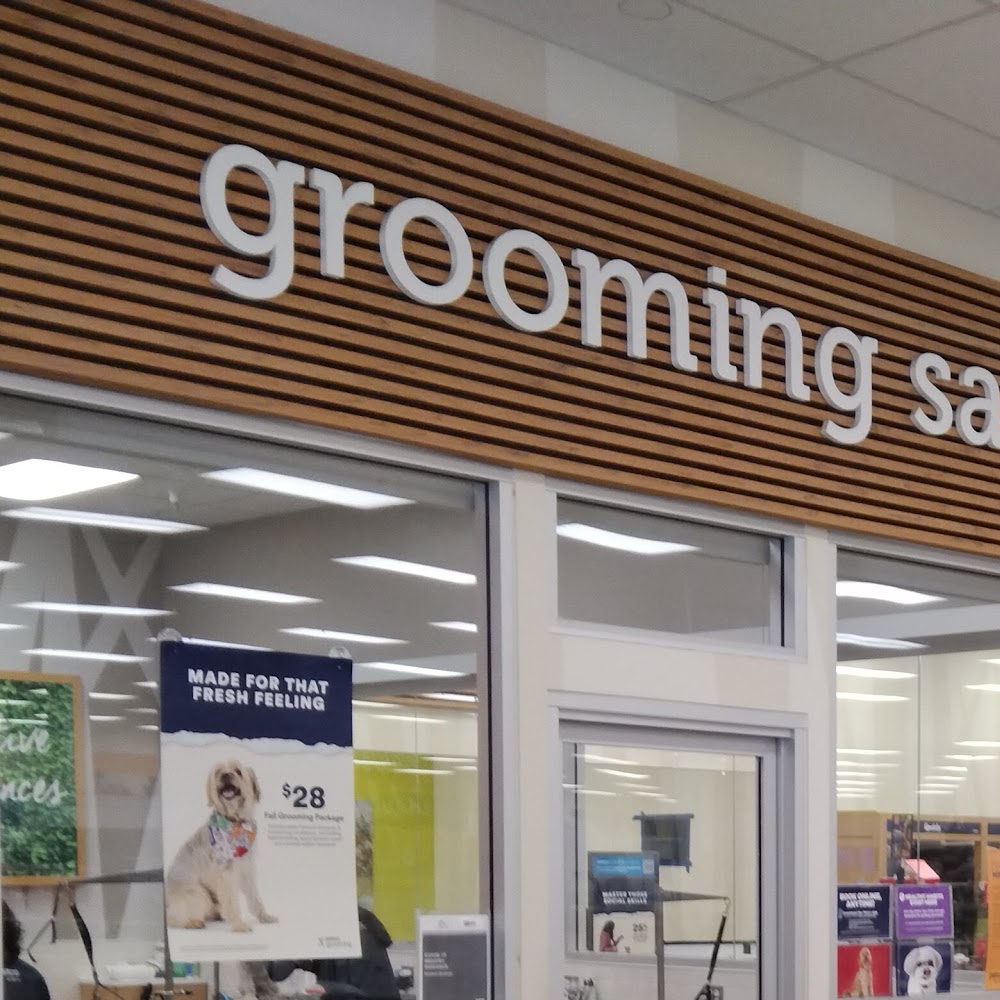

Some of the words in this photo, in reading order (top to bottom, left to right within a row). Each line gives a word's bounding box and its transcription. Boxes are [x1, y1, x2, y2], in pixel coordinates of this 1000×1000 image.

[200, 143, 880, 445] grooming
[187, 668, 240, 688] MADE
[245, 673, 280, 691] FOR
[283, 676, 330, 695] THAT
[192, 685, 249, 706] FRESH
[254, 690, 326, 712] FEELING
[282, 782, 326, 809] $28
